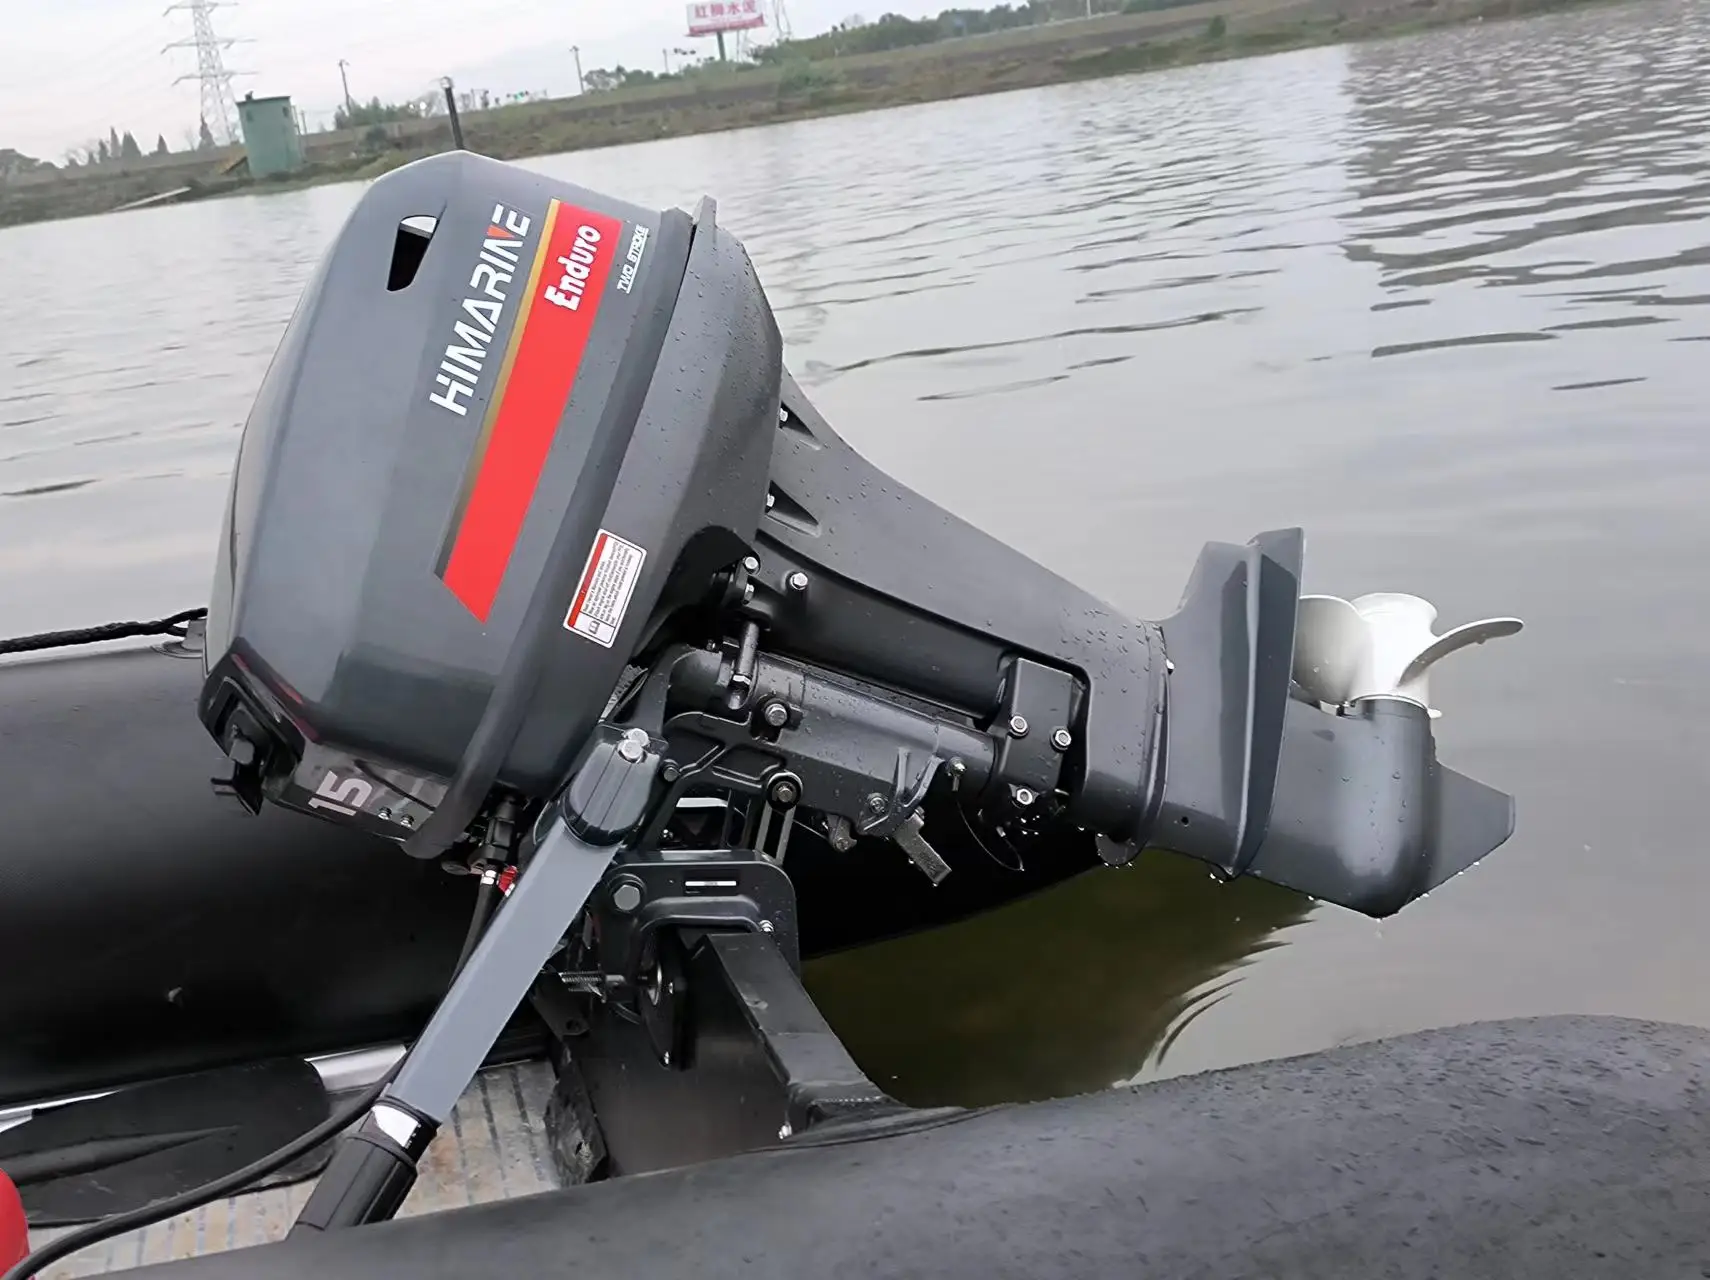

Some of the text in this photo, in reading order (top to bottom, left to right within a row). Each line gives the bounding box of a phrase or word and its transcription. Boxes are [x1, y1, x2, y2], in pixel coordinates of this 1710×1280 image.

[544, 224, 602, 312] Enduro
[616, 223, 648, 292] TWO STROKE
[429, 203, 532, 416] HIMARINE
[308, 770, 373, 816] 15
